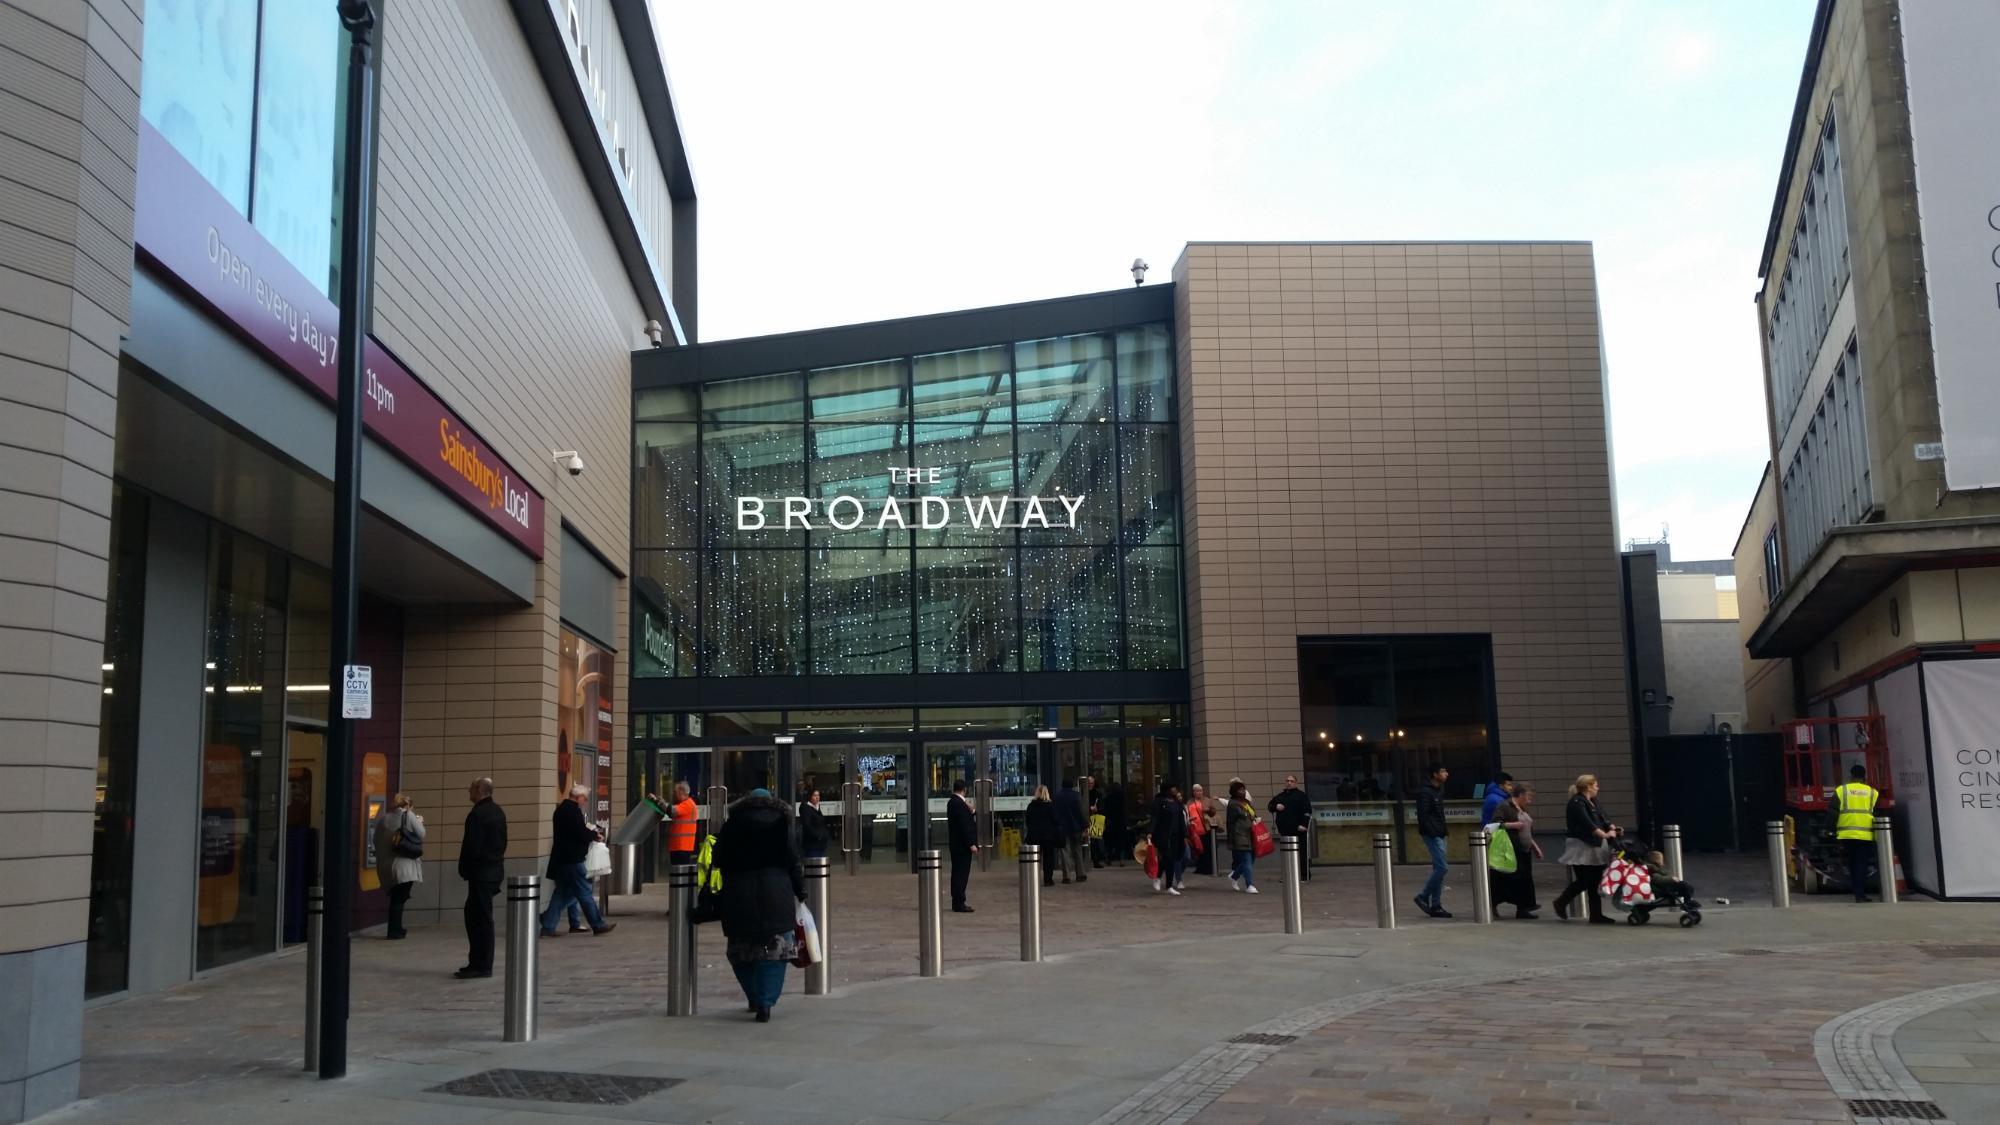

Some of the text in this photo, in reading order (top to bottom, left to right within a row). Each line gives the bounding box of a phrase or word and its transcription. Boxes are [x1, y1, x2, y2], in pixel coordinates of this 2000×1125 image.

[208, 226, 252, 295] Open
[256, 279, 298, 344] every
[302, 312, 328, 367] day
[366, 368, 395, 415] 11pm
[440, 418, 529, 529] Sainsbury's Local
[888, 467, 942, 484] THE
[737, 495, 1085, 531] BROADWAY
[346, 680, 369, 690] CCTV
[1956, 749, 2000, 765] CO
[1959, 771, 2000, 787] CIN
[1443, 809, 1476, 817] RADFORD
